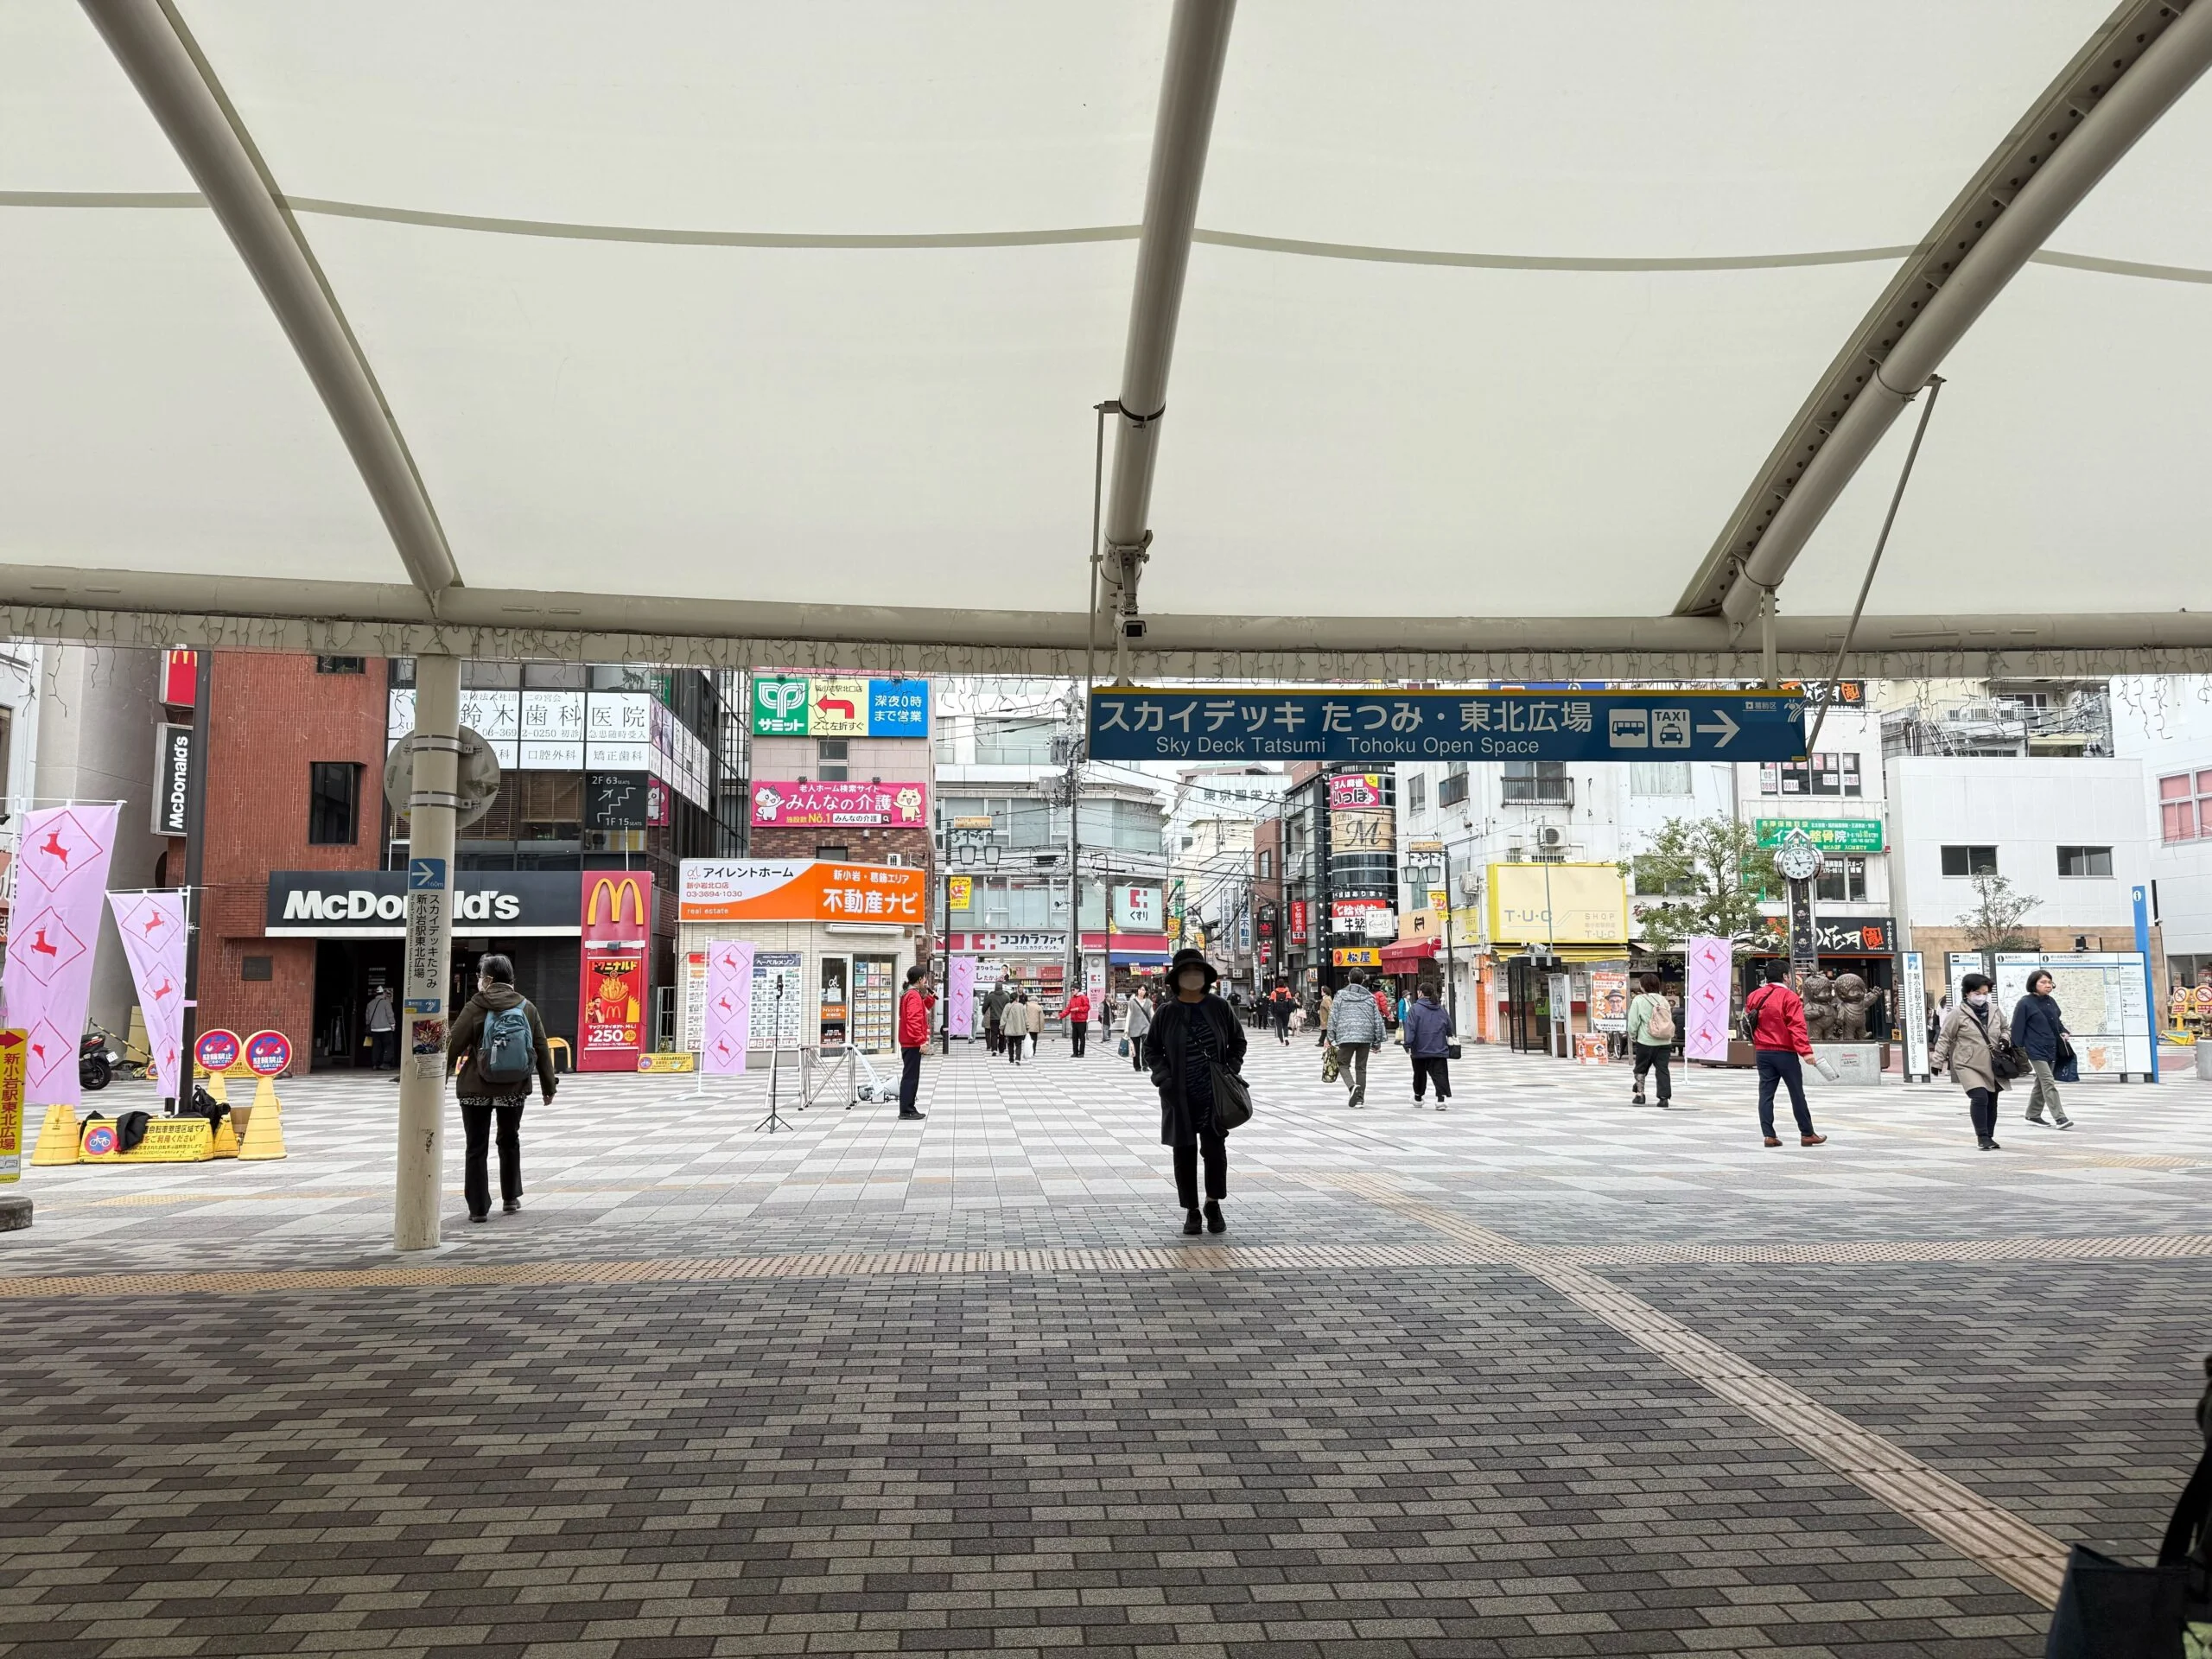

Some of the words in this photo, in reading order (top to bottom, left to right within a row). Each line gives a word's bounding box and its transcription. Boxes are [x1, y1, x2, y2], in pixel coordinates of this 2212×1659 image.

[525, 693, 561, 702] 二の宮会
[874, 695, 921, 708] 深夜0時
[874, 710, 922, 722] まで営業
[1099, 701, 1305, 733] スカイデッキ
[1322, 701, 1592, 733] たつみ・東北広場
[1655, 711, 1686, 721] TAXI
[758, 718, 804, 732] サミット
[813, 721, 864, 731] ここ左折すぐ
[1156, 737, 1191, 757] Sky
[1198, 737, 1244, 753] Deck
[1252, 737, 1325, 753] Tatsumi
[1347, 737, 1415, 753] Tohoku
[1424, 737, 1472, 757] Open
[1481, 737, 1539, 757] Space
[528, 750, 576, 760] 口腔外科
[594, 751, 643, 761] 矯正歯科
[169, 735, 188, 829] McDonald's
[592, 776, 603, 785] 2F
[1204, 789, 1278, 801] 東京聖栄大
[785, 794, 892, 811] みんなの介護
[606, 817, 616, 826] 1F
[703, 867, 793, 878] アイレントホーム
[283, 890, 520, 921] McDold's
[823, 888, 918, 915] 不動産ナビ
[1130, 911, 1148, 921] くすり
[413, 894, 428, 979] 新小岩駅東北広場
[426, 894, 440, 988] スカイデッキたつみ
[1001, 933, 1066, 944] ココカラファイ
[1347, 951, 1370, 963] 松屋
[592, 961, 638, 970] トクニナルド
[0, 1052, 20, 1151] 新小岩駅東北広場
